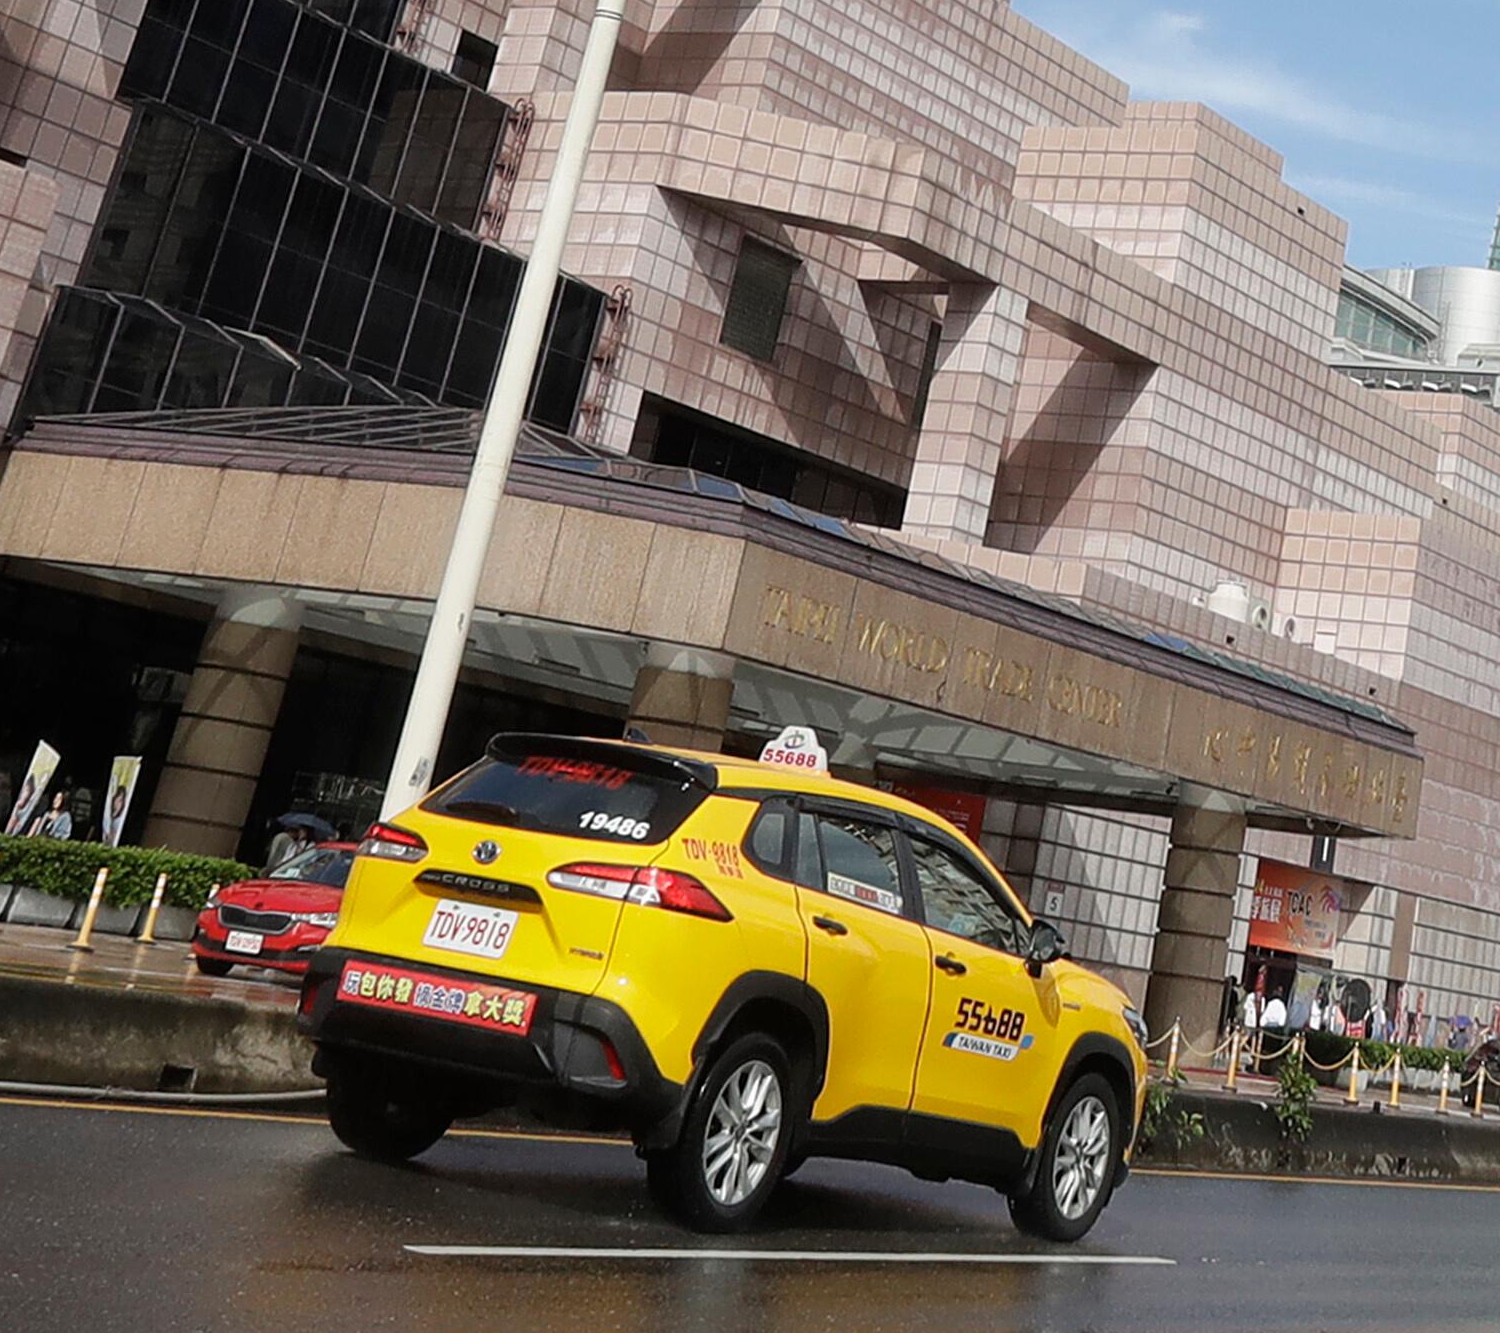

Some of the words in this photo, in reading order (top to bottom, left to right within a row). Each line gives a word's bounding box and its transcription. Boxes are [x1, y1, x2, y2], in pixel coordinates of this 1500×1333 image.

[856, 613, 948, 674] WORLD
[963, 644, 1035, 703] TRADE
[1047, 674, 1123, 728] CENTER
[762, 748, 817, 768] 55688
[578, 811, 651, 840] 19486
[442, 873, 510, 893] CROSS
[954, 996, 1026, 1042] 55688
[958, 1035, 992, 1054] TAIWAN
[992, 1044, 1012, 1059] TAXI
